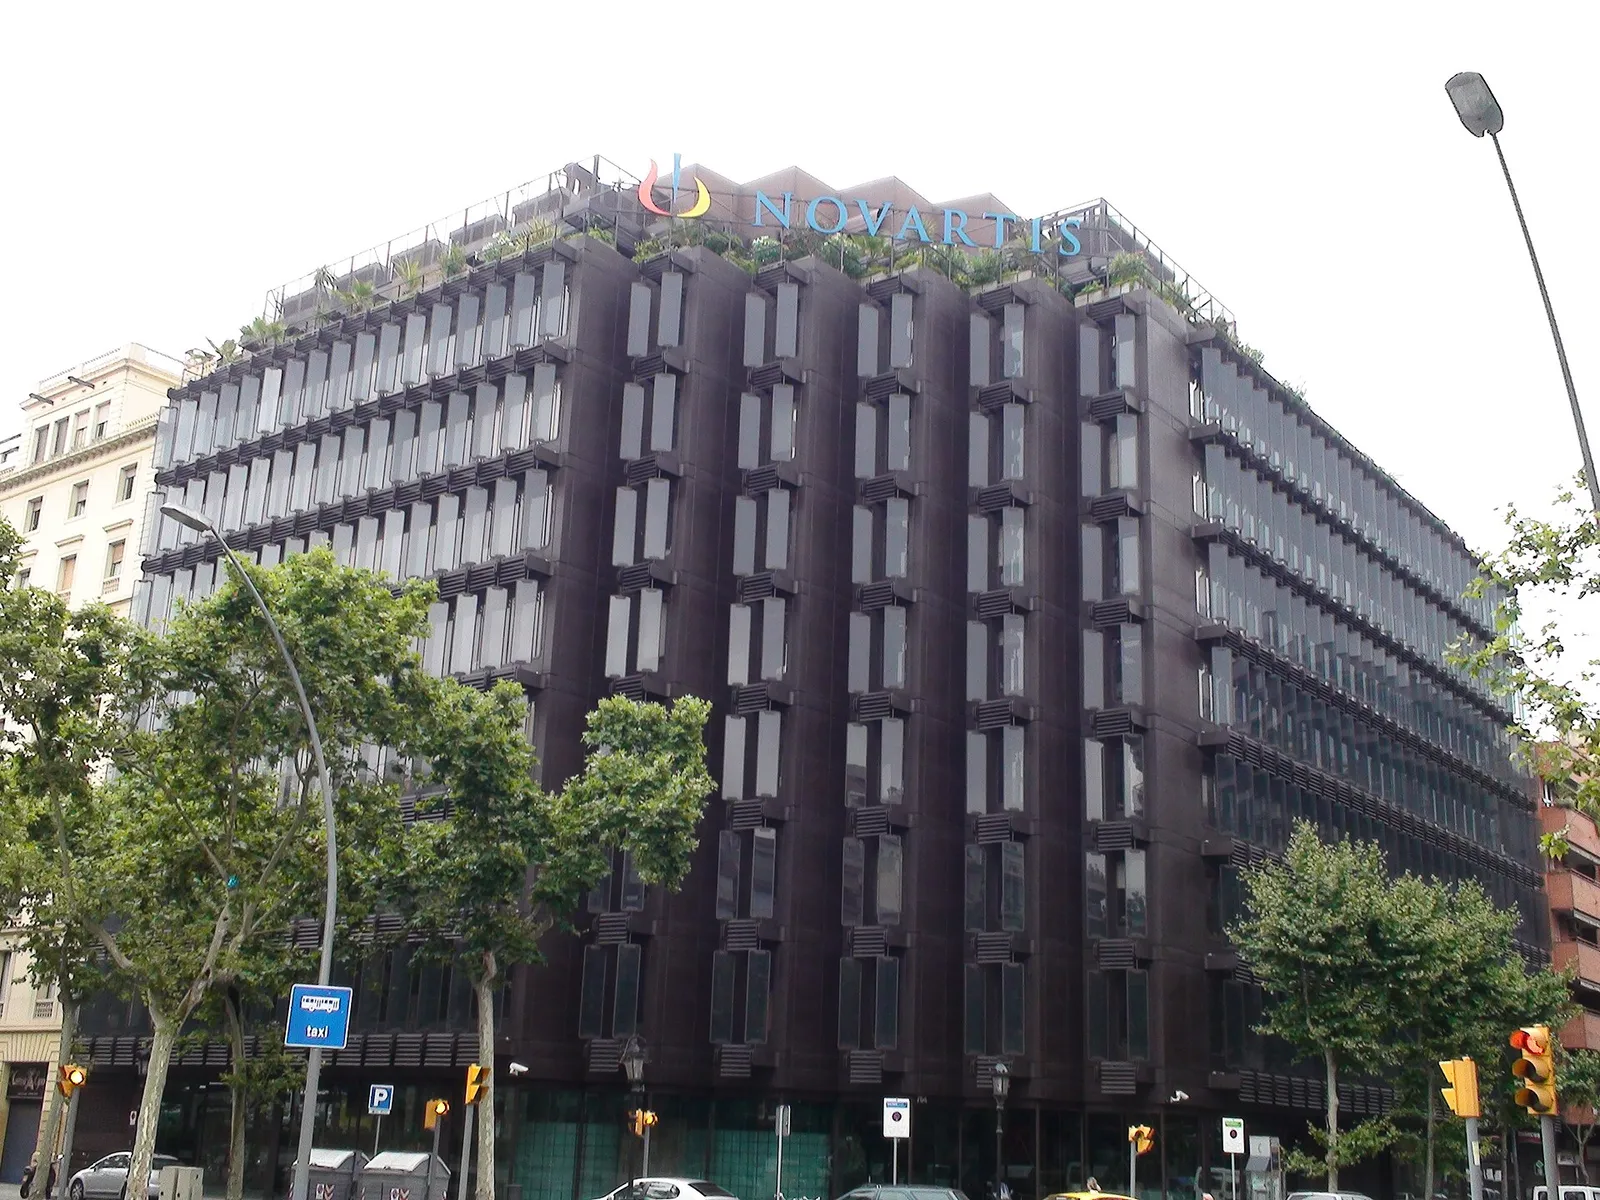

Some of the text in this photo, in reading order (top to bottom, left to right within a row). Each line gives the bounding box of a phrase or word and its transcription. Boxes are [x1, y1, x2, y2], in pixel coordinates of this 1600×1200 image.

[751, 190, 1082, 256] NOVARTIS
[306, 1025, 328, 1038] taxi
[373, 1088, 388, 1107] P
